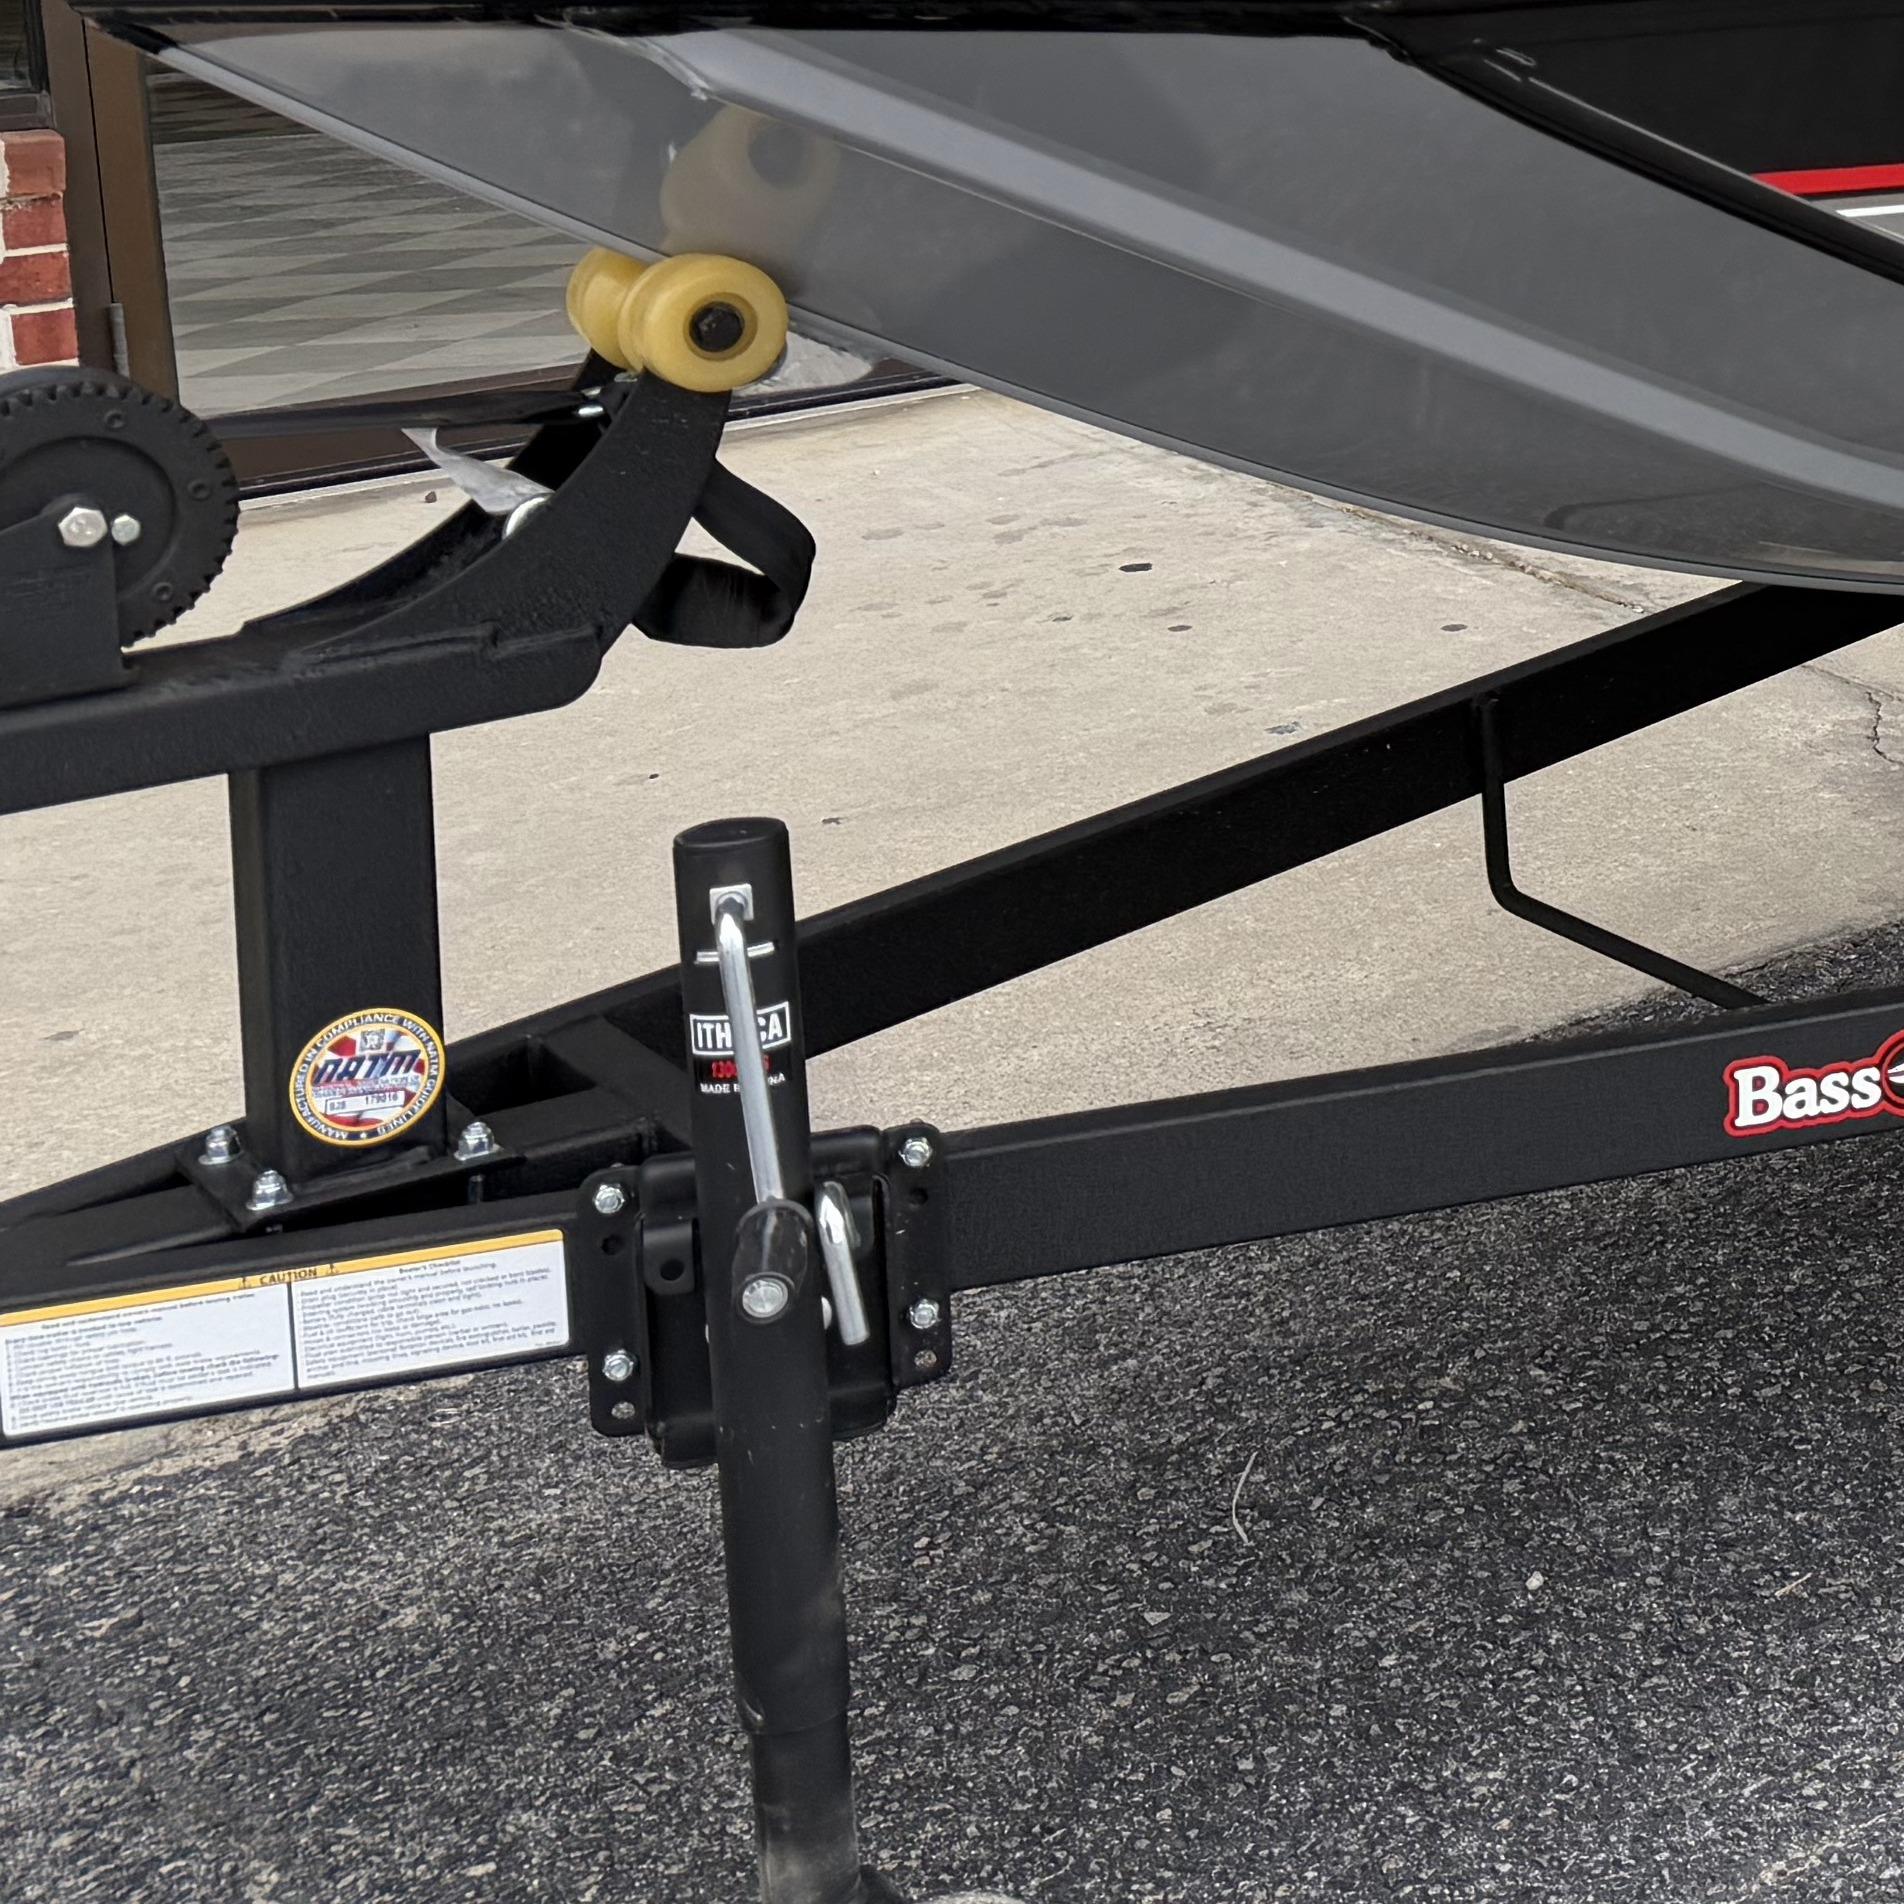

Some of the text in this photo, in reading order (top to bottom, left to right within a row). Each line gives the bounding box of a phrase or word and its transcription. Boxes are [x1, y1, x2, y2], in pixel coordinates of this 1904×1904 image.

[316, 1013, 400, 1048] COMPLIANCE
[402, 1018, 430, 1044] WITH
[697, 1012, 783, 1049] ITHA
[700, 1082, 731, 1094] MADE
[1732, 1065, 1882, 1127] Bass
[259, 1267, 318, 1286] CAUTION
